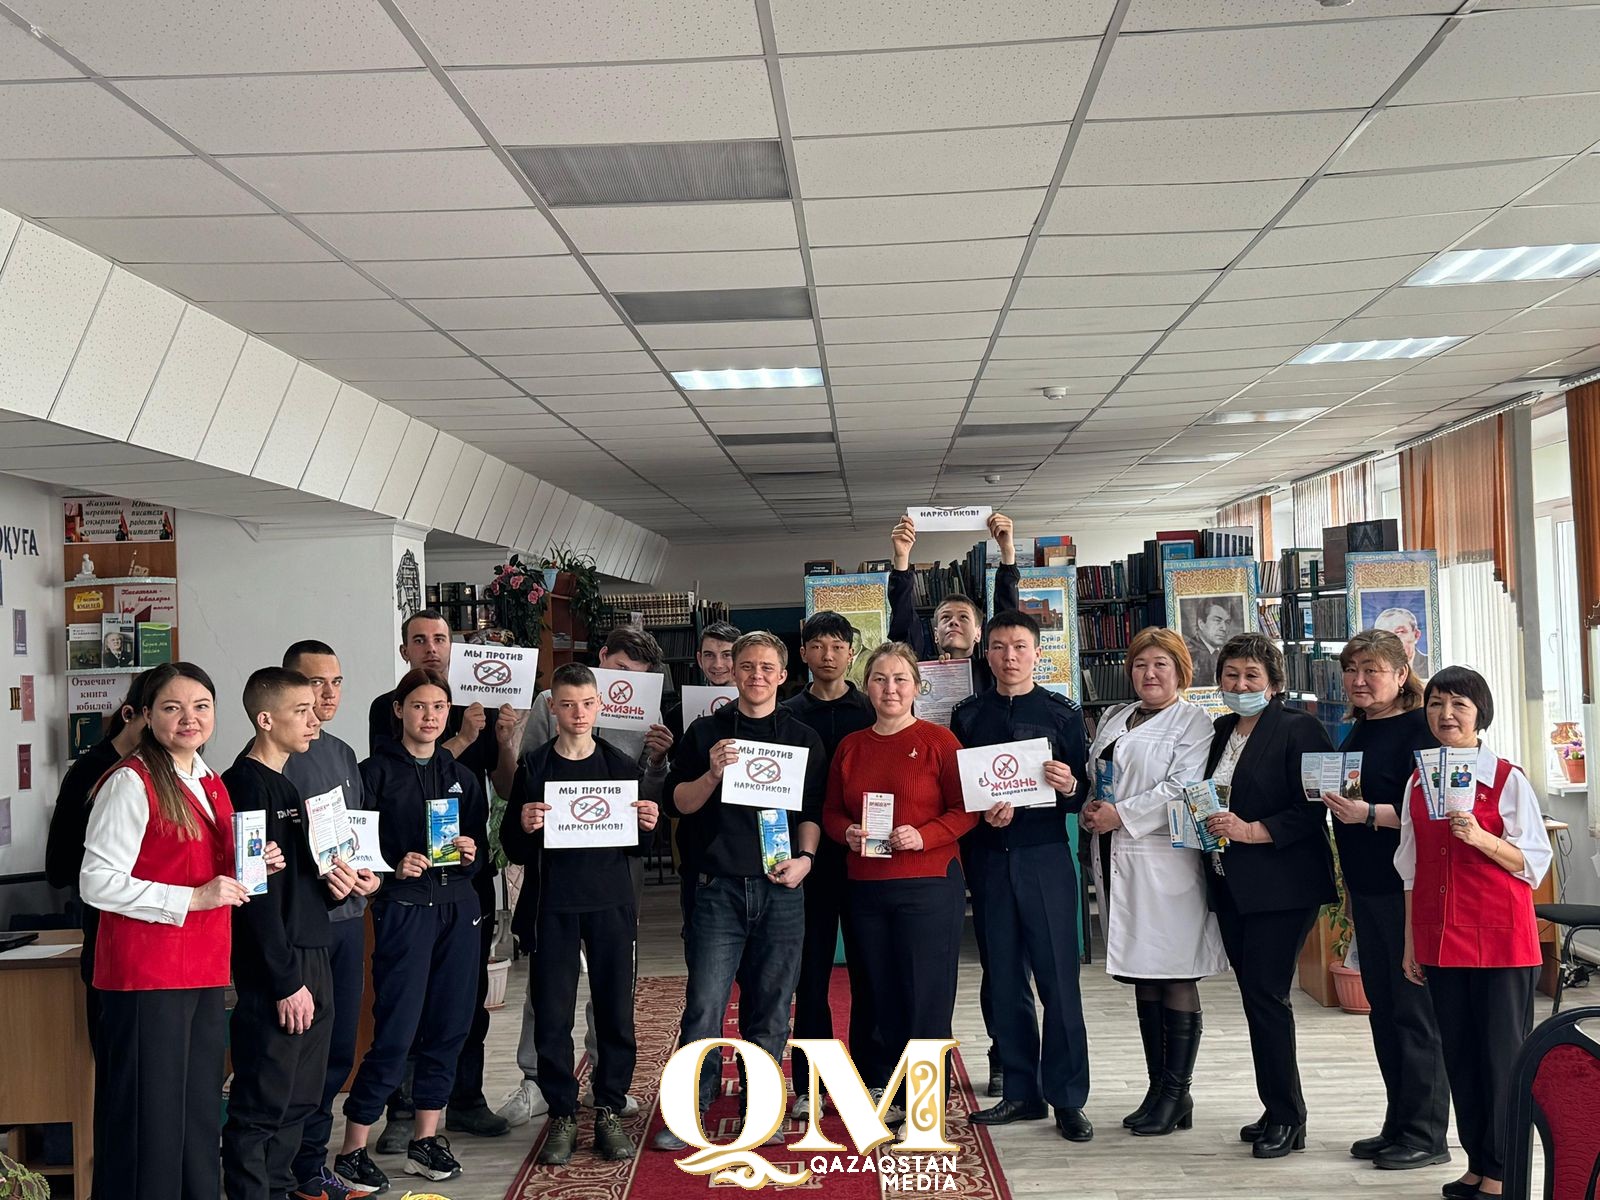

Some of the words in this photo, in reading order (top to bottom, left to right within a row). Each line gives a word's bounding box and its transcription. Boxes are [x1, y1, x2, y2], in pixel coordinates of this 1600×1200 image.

[920, 509, 980, 518] НАРКОТИКОВ!
[0, 525, 40, 560] ҚУҒА
[464, 649, 482, 658] МЫ
[486, 651, 524, 661] ПРОТИВ
[71, 677, 117, 687] Отмечает
[460, 684, 522, 695] НАРКОТИКОВ!
[76, 701, 113, 711] юбилей
[601, 704, 645, 716] ЖИЗНЬ
[739, 745, 755, 755] МЫ
[758, 748, 794, 760] ПРОТИВ
[733, 781, 791, 795] НАРКОТИКОВ!
[990, 777, 1037, 792] ЖИЗНЬ
[558, 787, 578, 795] МЫ
[581, 786, 622, 795] ПРОТИВ
[558, 823, 624, 832] НАРКОТИКОВ!
